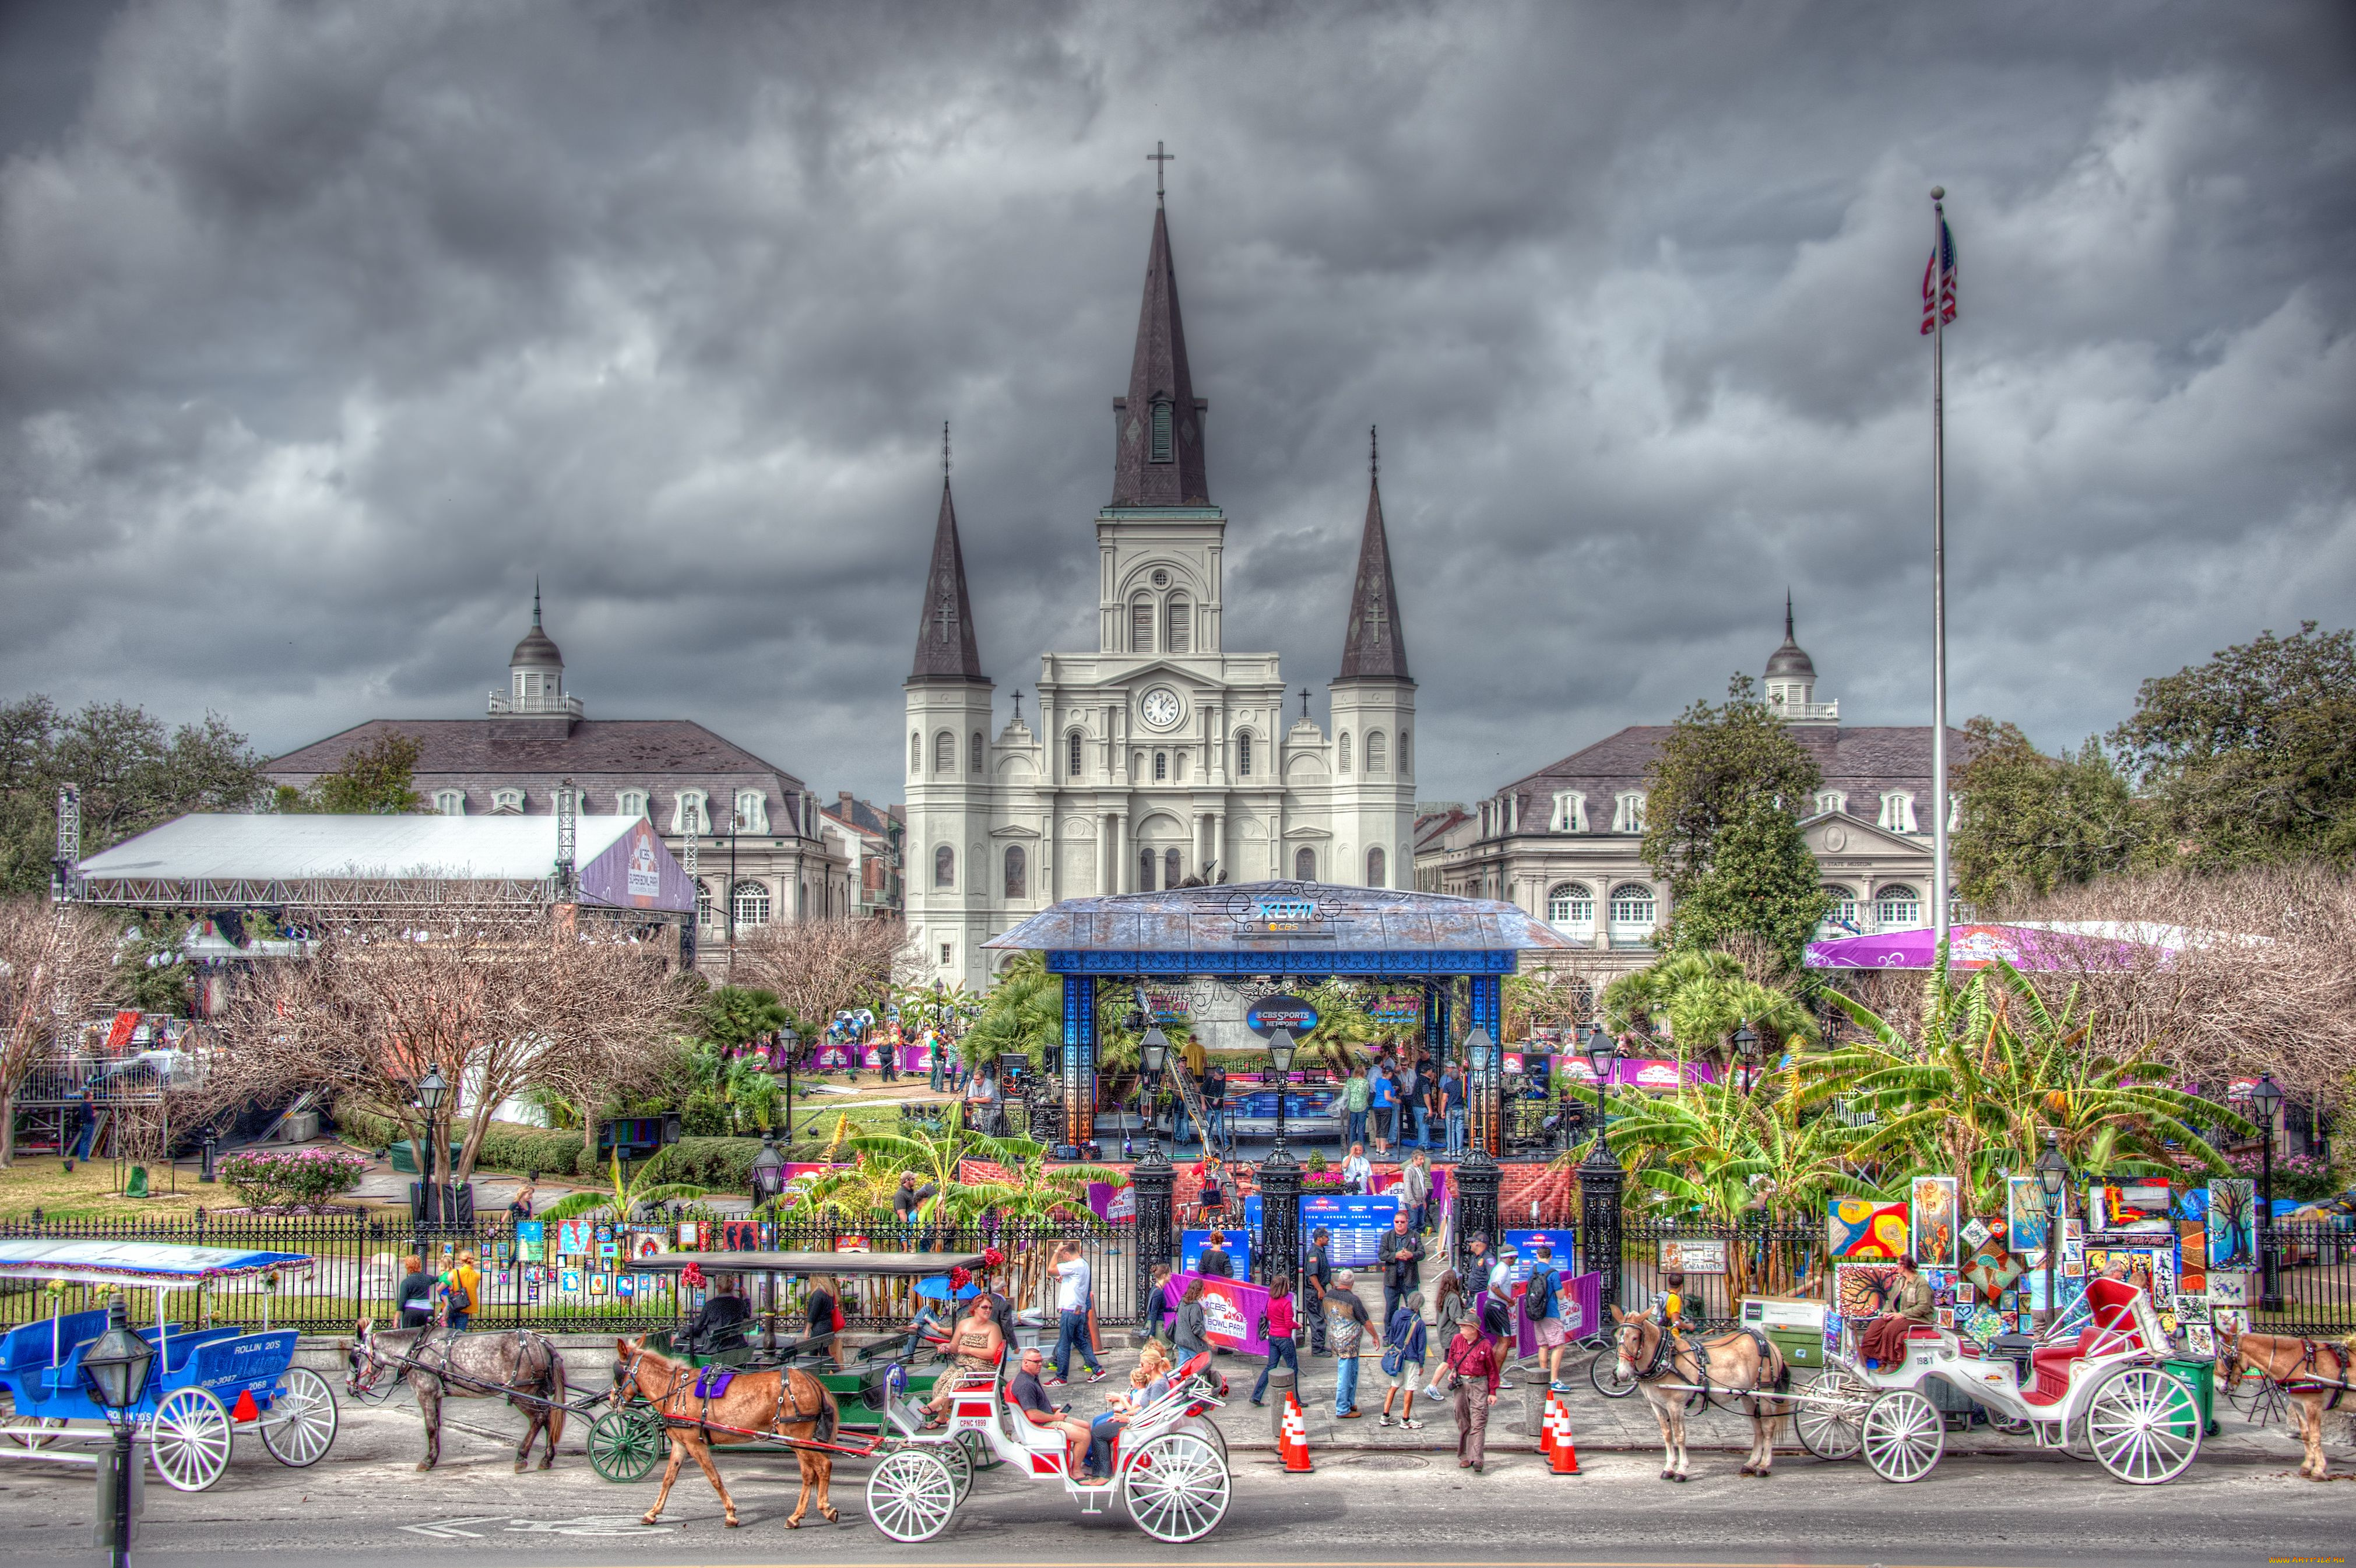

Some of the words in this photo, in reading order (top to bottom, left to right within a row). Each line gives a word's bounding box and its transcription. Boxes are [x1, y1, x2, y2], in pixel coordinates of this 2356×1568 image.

[1255, 903, 1314, 919] XLVII
[1370, 1001, 1420, 1015] XLVII
[1277, 1012, 1309, 1021] SPORTS
[1209, 1302, 1227, 1312] CBS
[1208, 1318, 1228, 1328] BOWL
[1229, 1322, 1245, 1333] PARK
[234, 1343, 262, 1355] ROLLIN
[265, 1340, 282, 1351] 20'S
[248, 1380, 266, 1390] 2068
[107, 1409, 133, 1421] ROLIN
[975, 1419, 986, 1427] 1899
